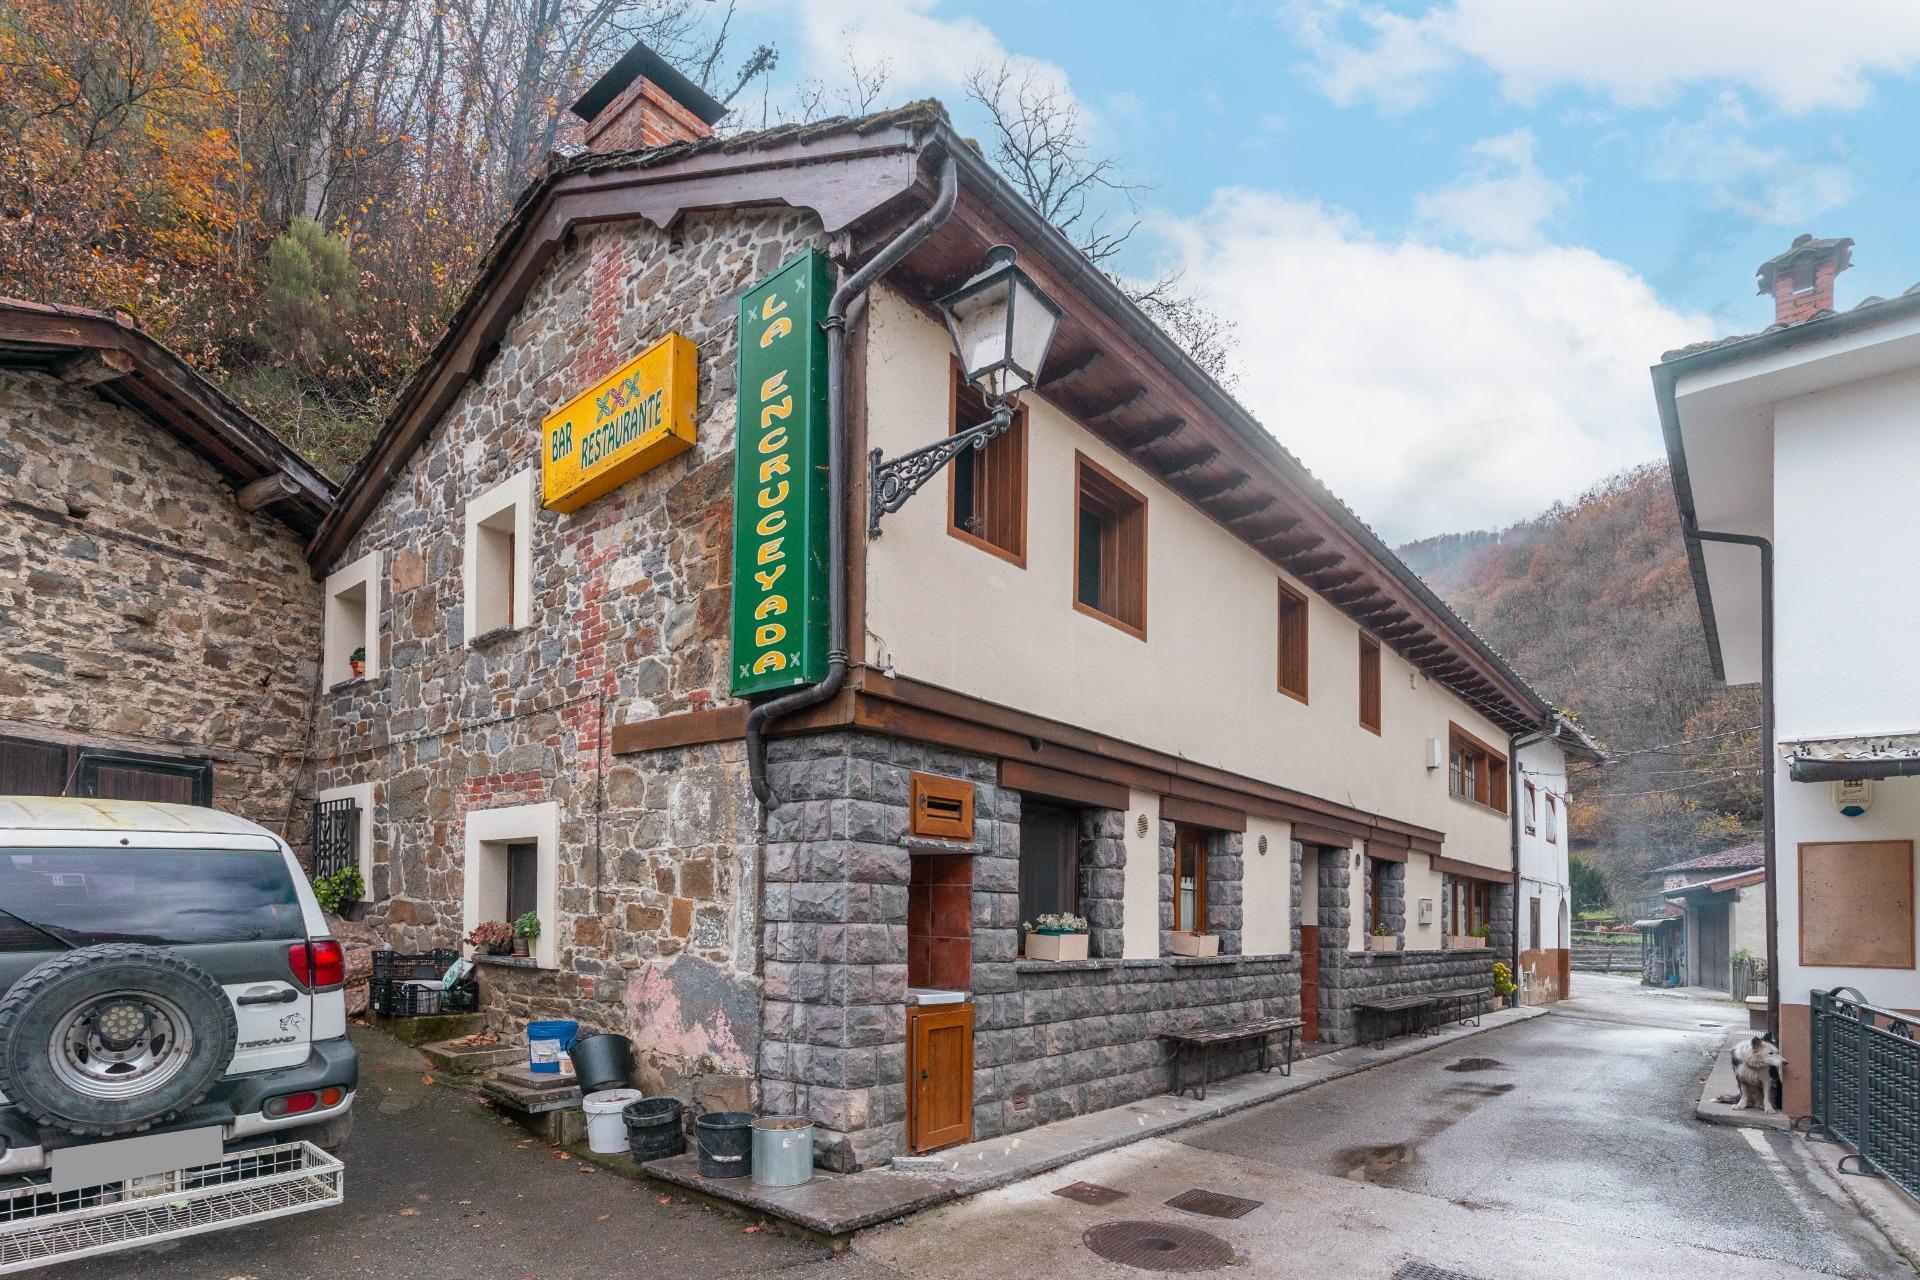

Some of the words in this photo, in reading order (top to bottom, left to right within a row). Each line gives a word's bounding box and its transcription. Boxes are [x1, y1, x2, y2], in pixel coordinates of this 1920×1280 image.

[760, 293, 792, 349] LA
[551, 421, 573, 463] BAR
[580, 389, 663, 470] RESTAURANTE
[752, 369, 792, 675] ENCRUCEYADA
[238, 1035, 296, 1049] TERRANO
